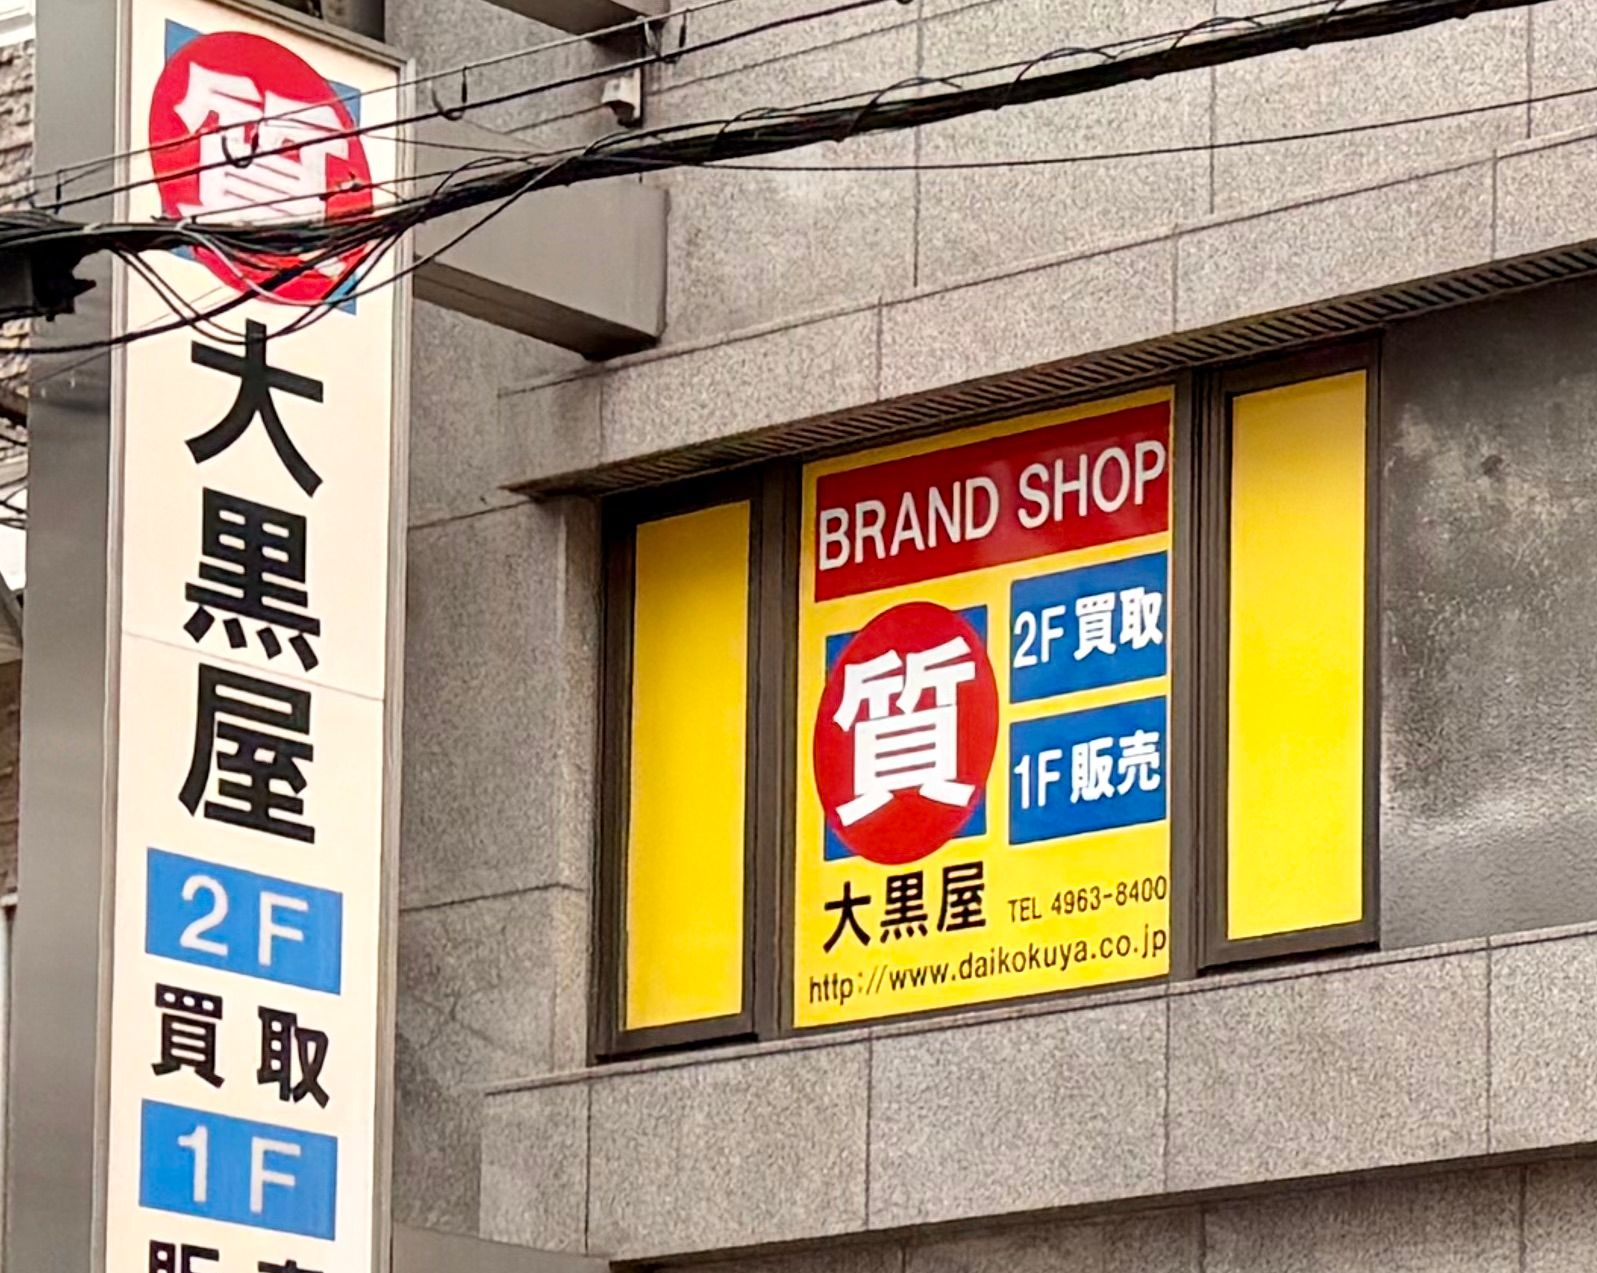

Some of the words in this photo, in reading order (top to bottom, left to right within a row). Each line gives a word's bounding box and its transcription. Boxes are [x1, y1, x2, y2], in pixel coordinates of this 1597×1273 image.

[819, 475, 999, 572] BRAND
[1017, 440, 1167, 529] SHOP
[178, 318, 324, 844] 大黒屋
[833, 636, 976, 827] 質
[178, 874, 310, 966] 2F
[822, 861, 986, 954] 大黒屋
[1008, 895, 1043, 924] TEL
[1051, 876, 1167, 917] 4963-8400
[809, 924, 1167, 1006] http://www.daikokuya.co.jp
[151, 983, 330, 1109] 買取
[176, 1125, 302, 1214] 1F
